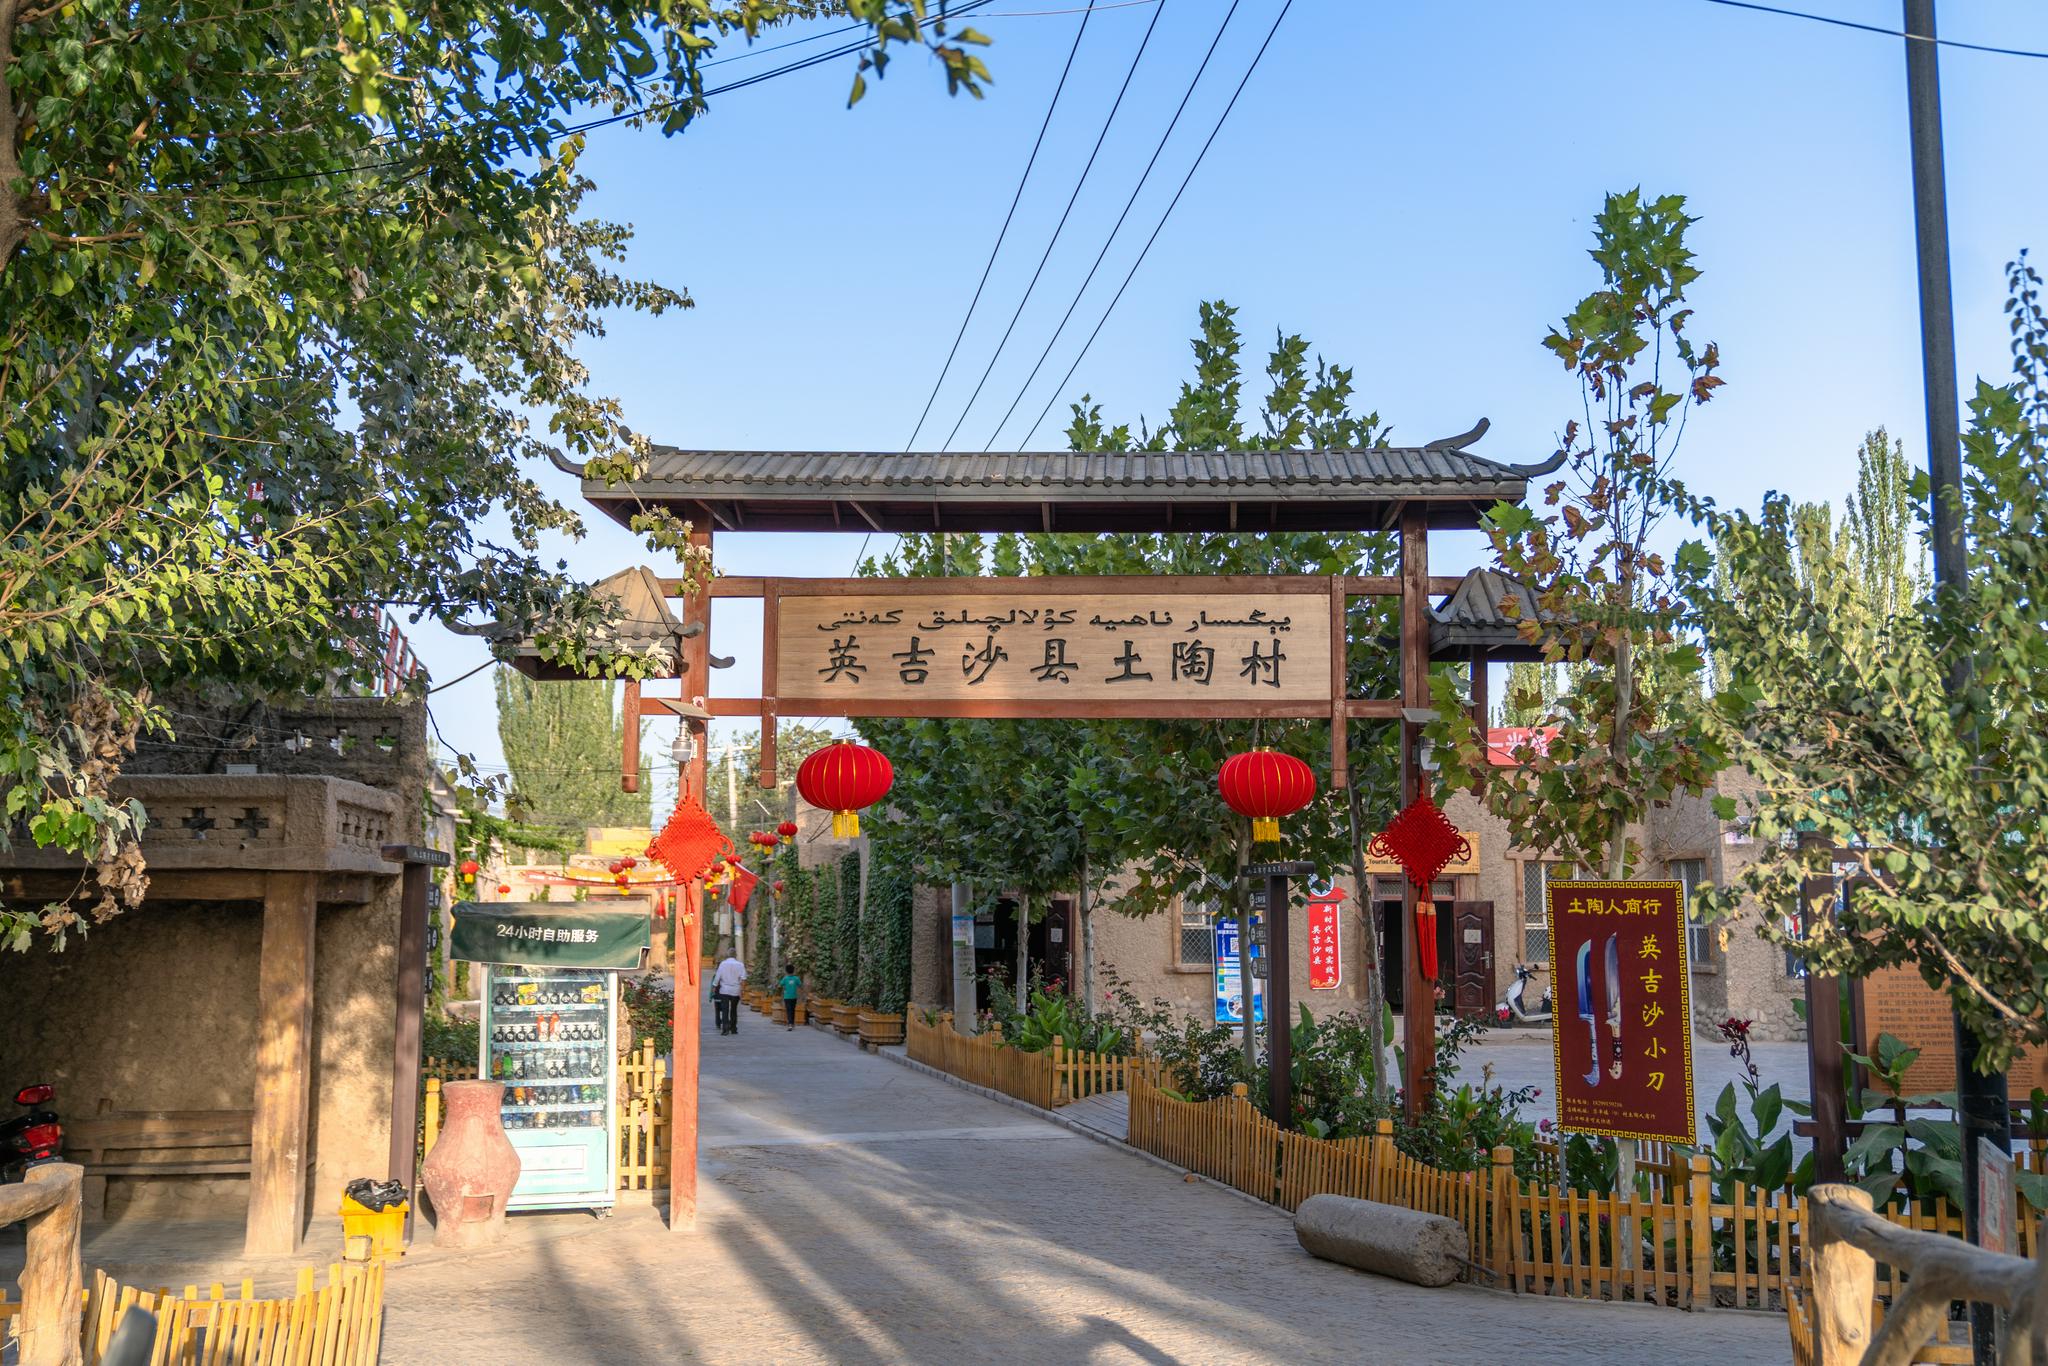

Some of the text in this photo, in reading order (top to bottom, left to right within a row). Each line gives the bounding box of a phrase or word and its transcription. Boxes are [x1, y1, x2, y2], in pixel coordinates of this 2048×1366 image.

[818, 635, 1287, 688] 英吉沙县土陶村
[1568, 898, 1662, 916] 土陶人商行
[496, 923, 600, 944] 24小时自助服务
[1638, 934, 1668, 1092] 英吉沙小刀
